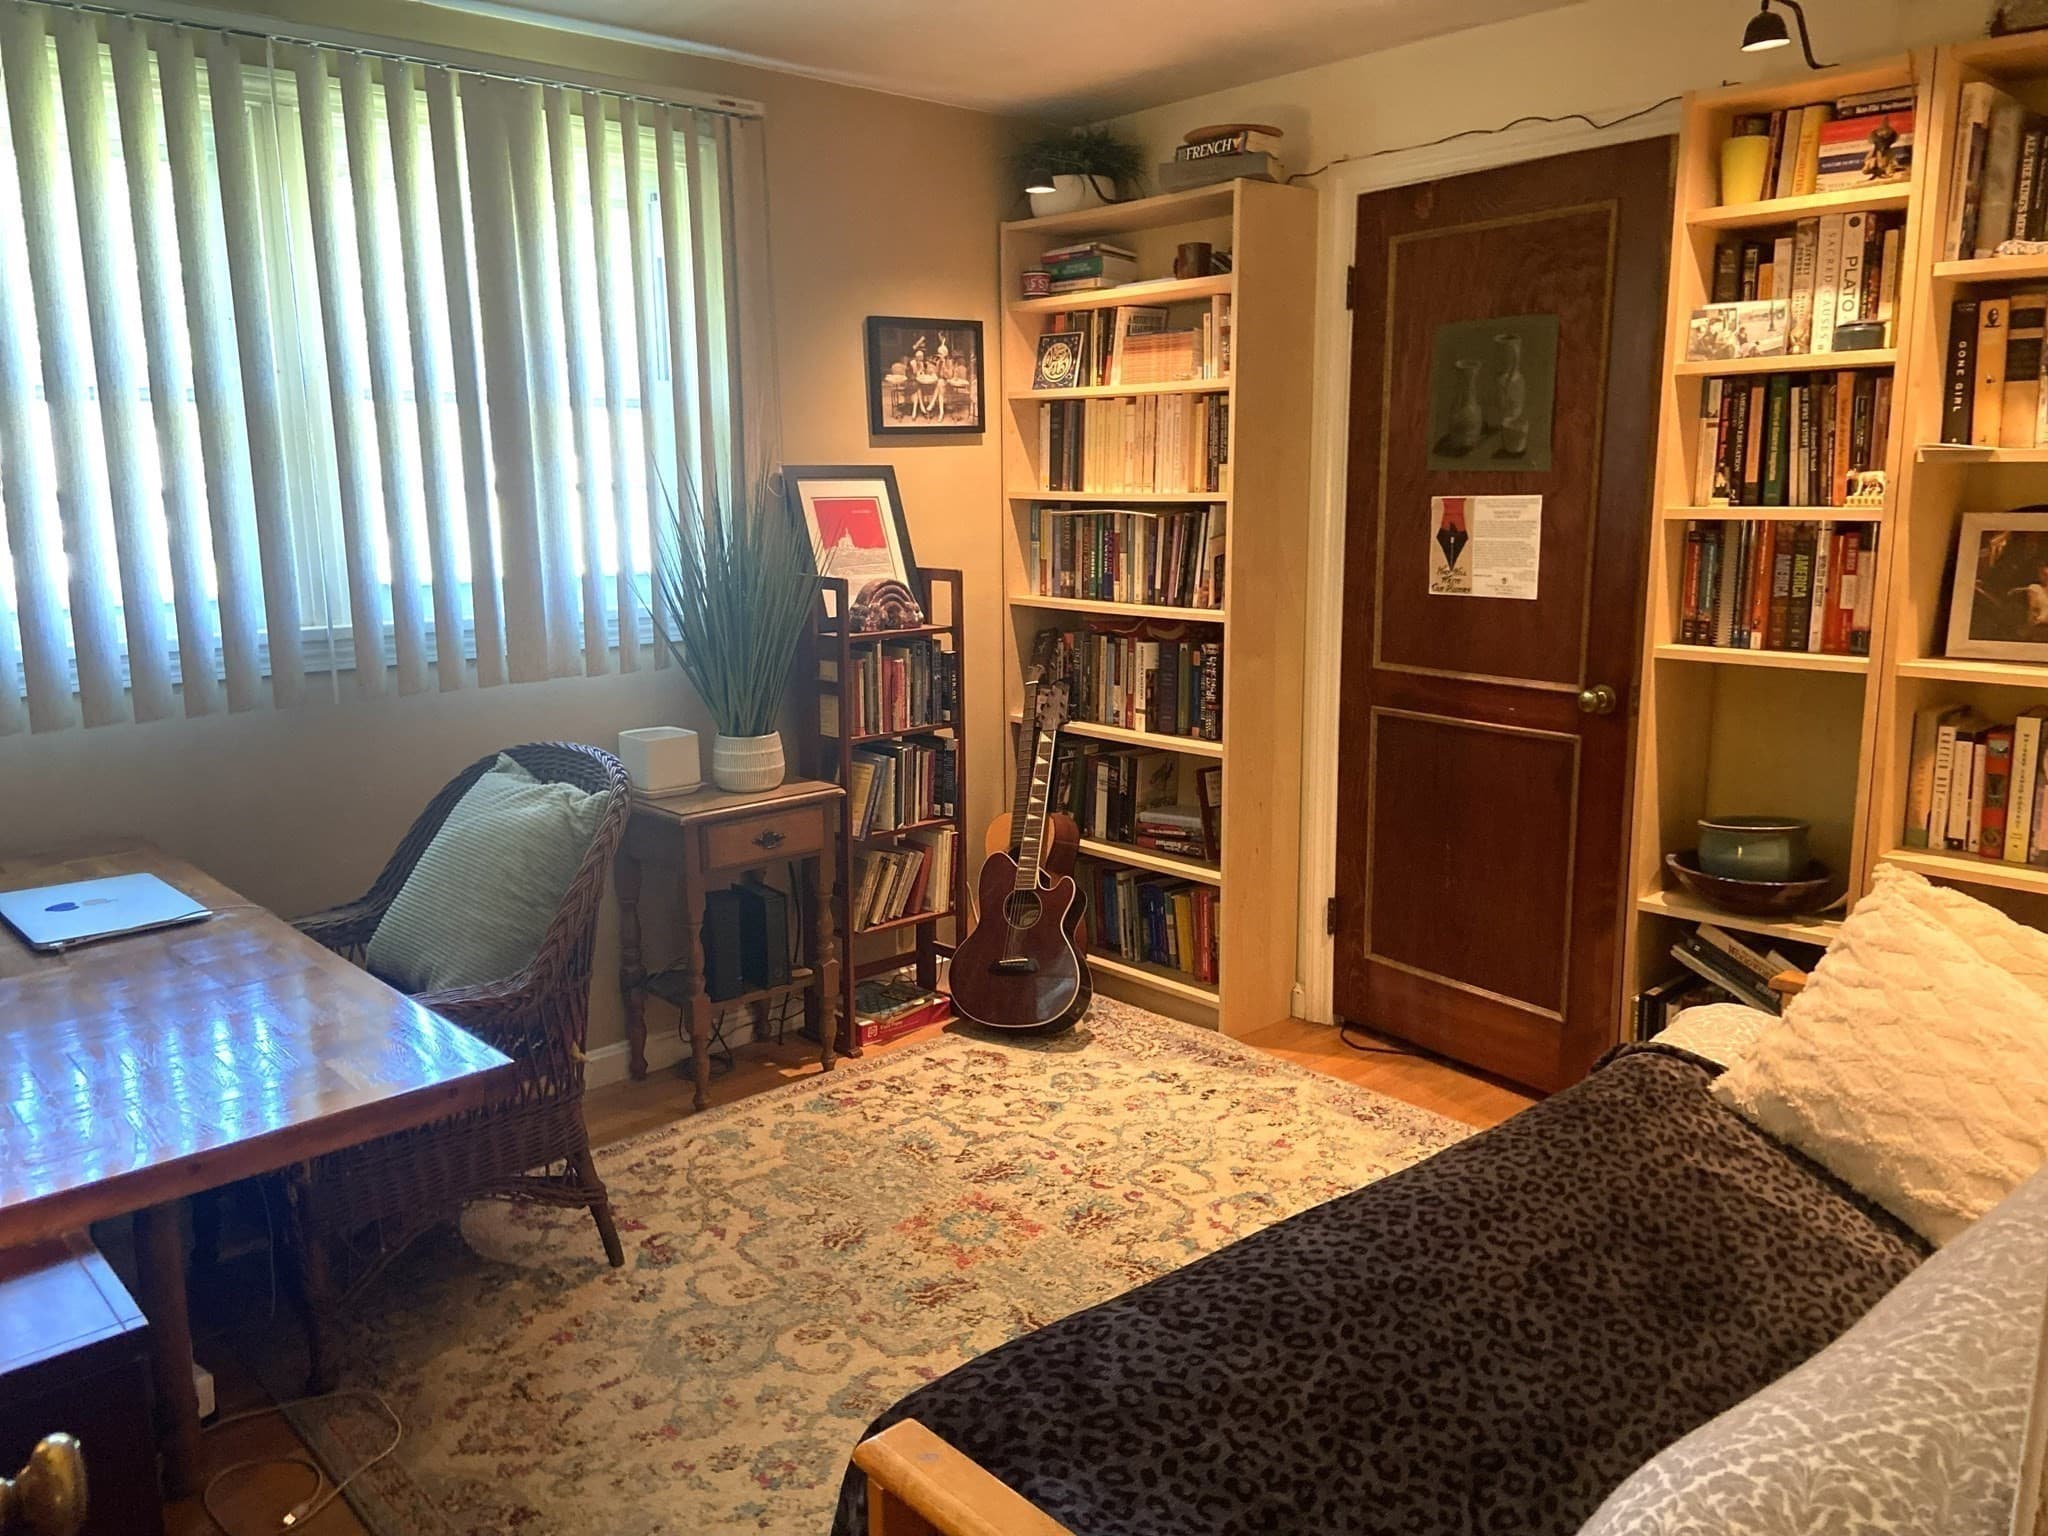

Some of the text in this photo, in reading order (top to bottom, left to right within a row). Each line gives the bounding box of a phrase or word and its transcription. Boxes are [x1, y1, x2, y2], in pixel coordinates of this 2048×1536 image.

[1185, 138, 1232, 160] FRENCH
[2015, 135, 2036, 237] ALL THE KING'S MEN
[1819, 232, 1837, 339] SACRED CAUSES
[1842, 255, 1859, 313] PLATO
[1952, 340, 1968, 413] GONE GIRL
[1734, 391, 1747, 474] AMERICAN EDUCATION
[1801, 421, 1809, 446] HISTORY
[1774, 553, 1791, 598] AMERICA
[1791, 553, 1809, 599] AMERICA
